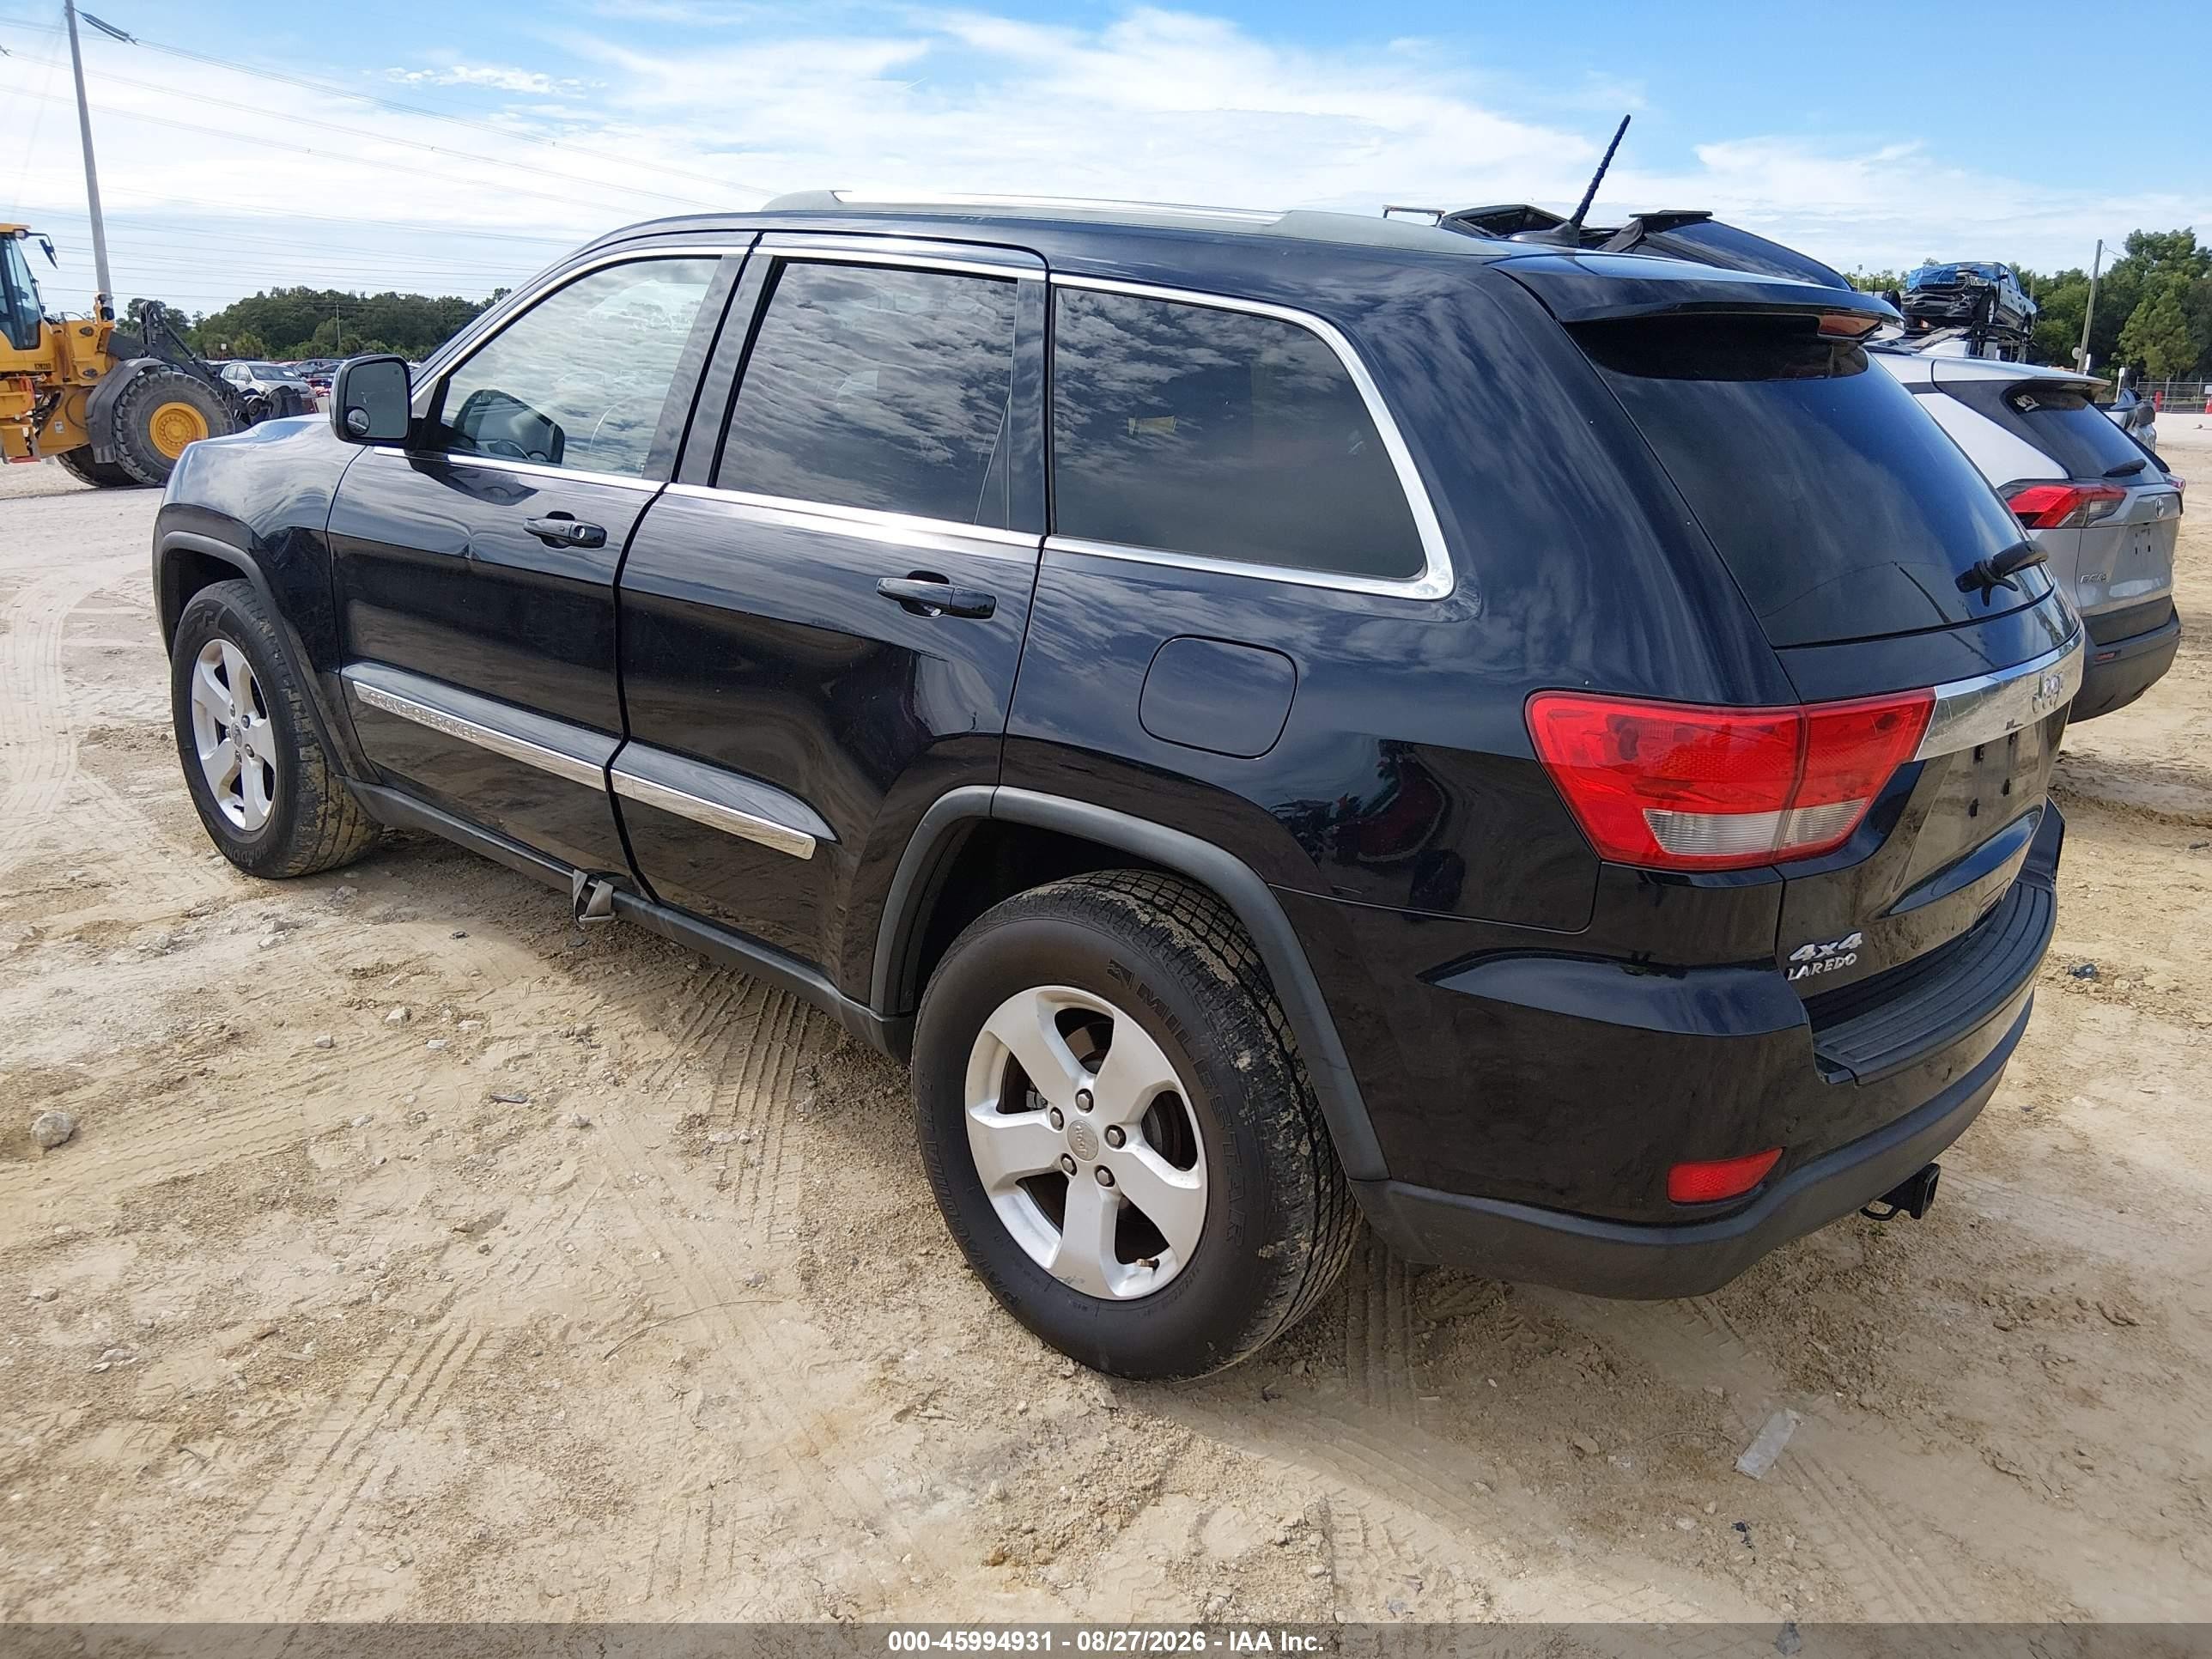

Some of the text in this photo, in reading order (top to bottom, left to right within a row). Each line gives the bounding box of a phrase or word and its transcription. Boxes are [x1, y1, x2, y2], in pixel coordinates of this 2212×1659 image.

[413, 704, 478, 742] CHEROKEE
[1787, 951, 1857, 981] LAREDO
[1135, 981, 1247, 1248] MILESTAR
